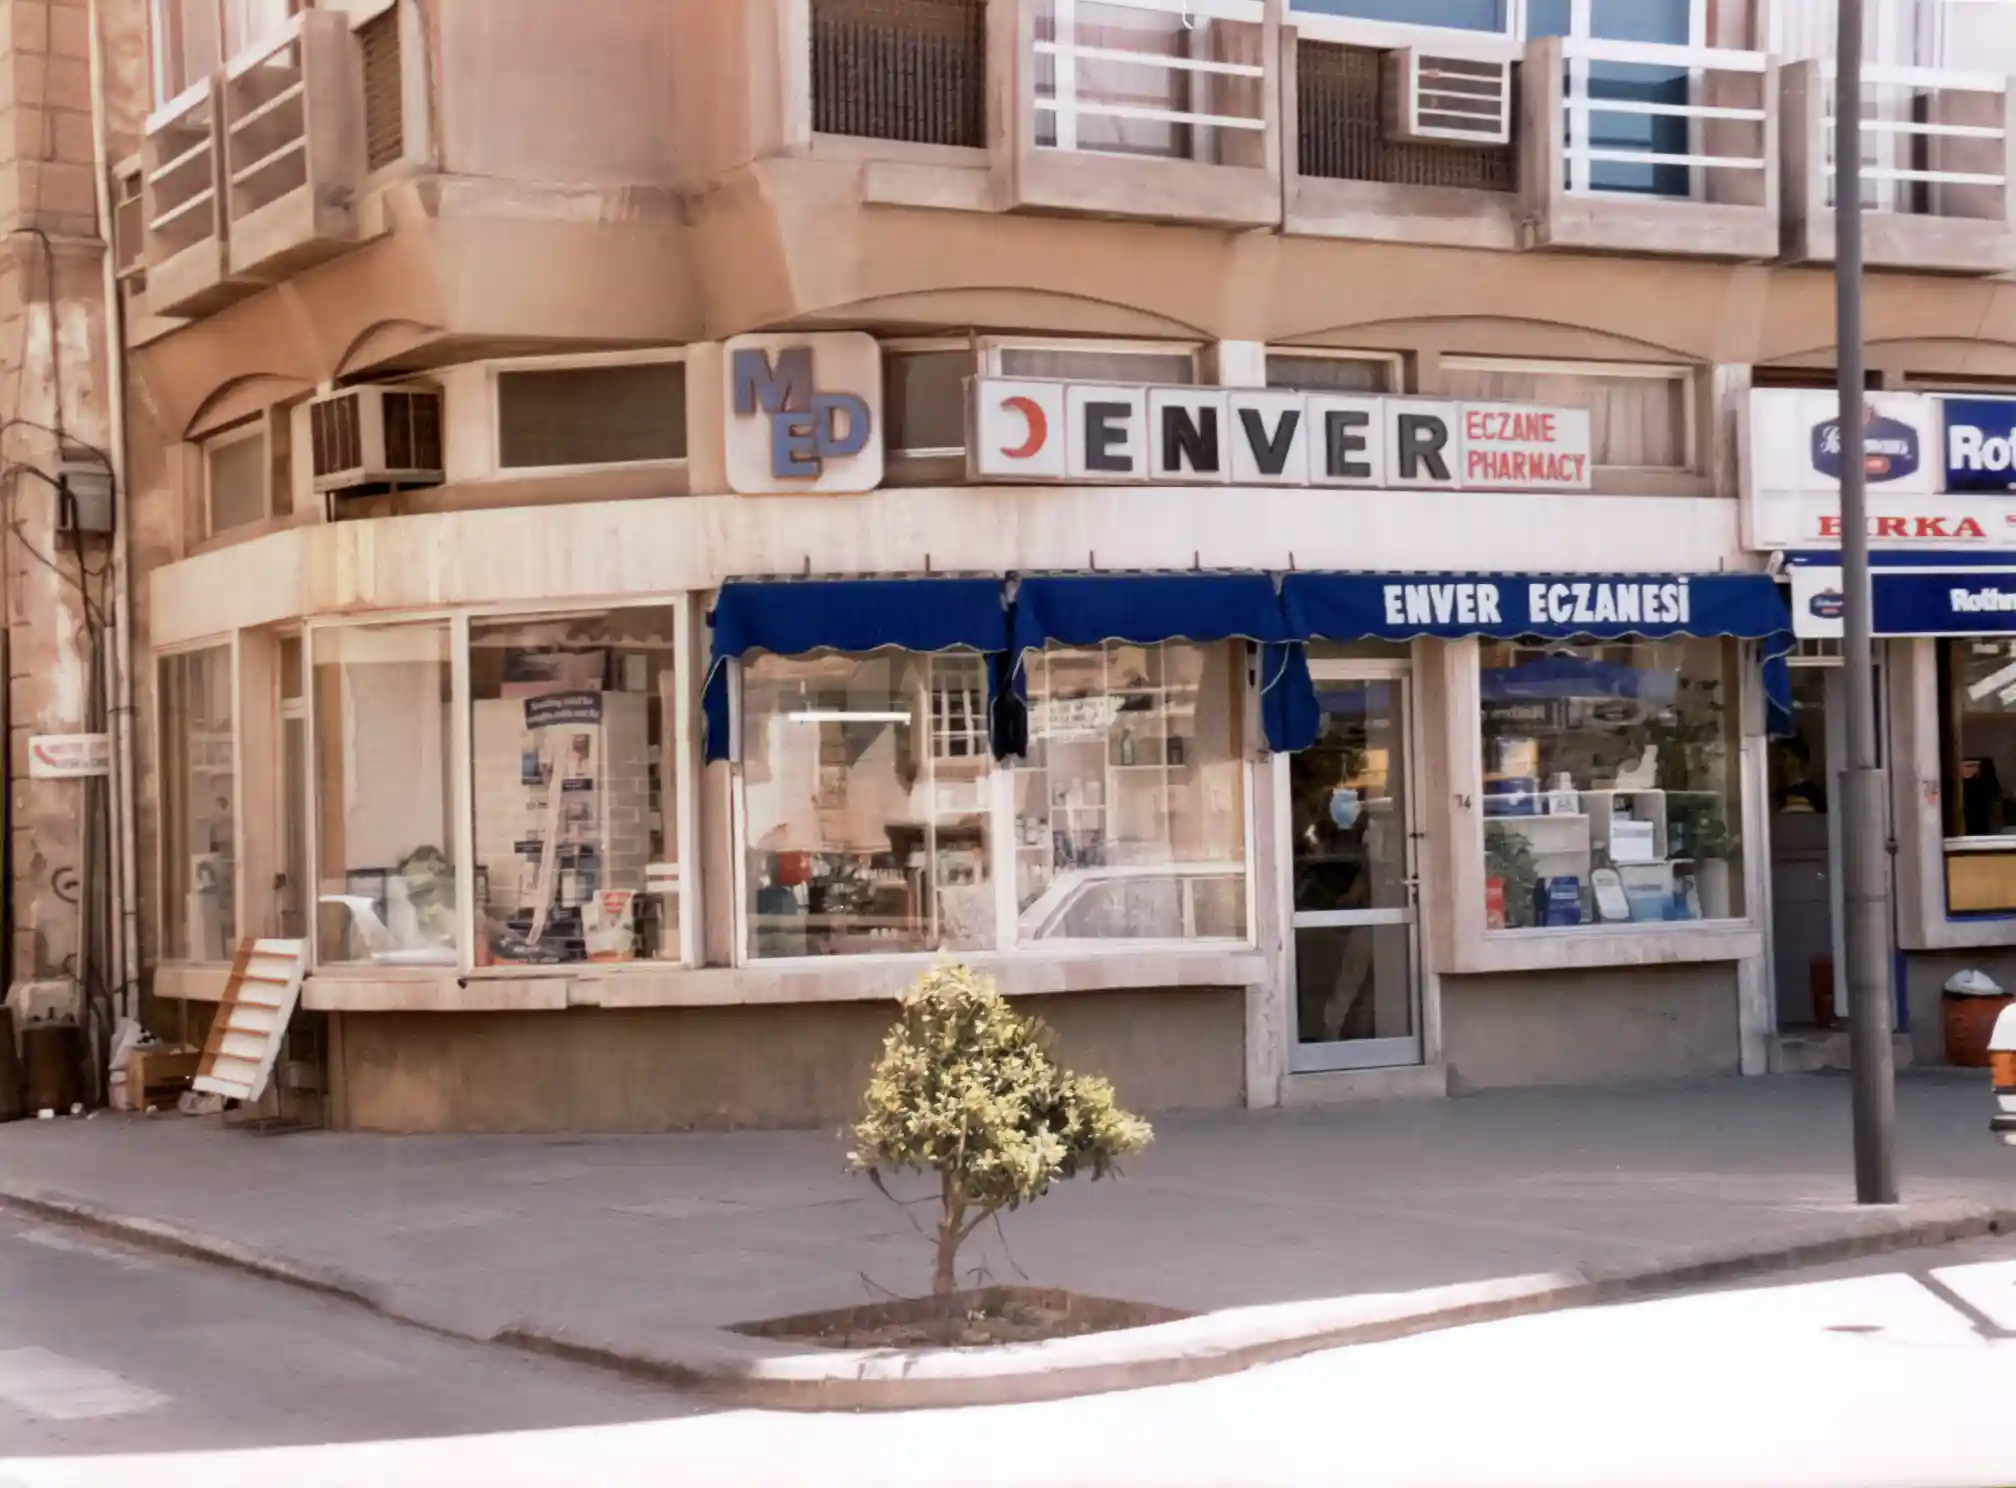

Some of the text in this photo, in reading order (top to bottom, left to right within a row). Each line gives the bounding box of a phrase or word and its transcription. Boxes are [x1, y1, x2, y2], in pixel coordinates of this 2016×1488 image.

[732, 346, 872, 479] MED
[1466, 410, 1557, 442] ECZANE
[1084, 401, 1452, 481] ENVER
[1466, 449, 1586, 482] PHARMACY
[1818, 515, 1987, 538] BRKA
[1384, 582, 1502, 625] ENVER
[1528, 577, 1690, 624] ECZANESİ
